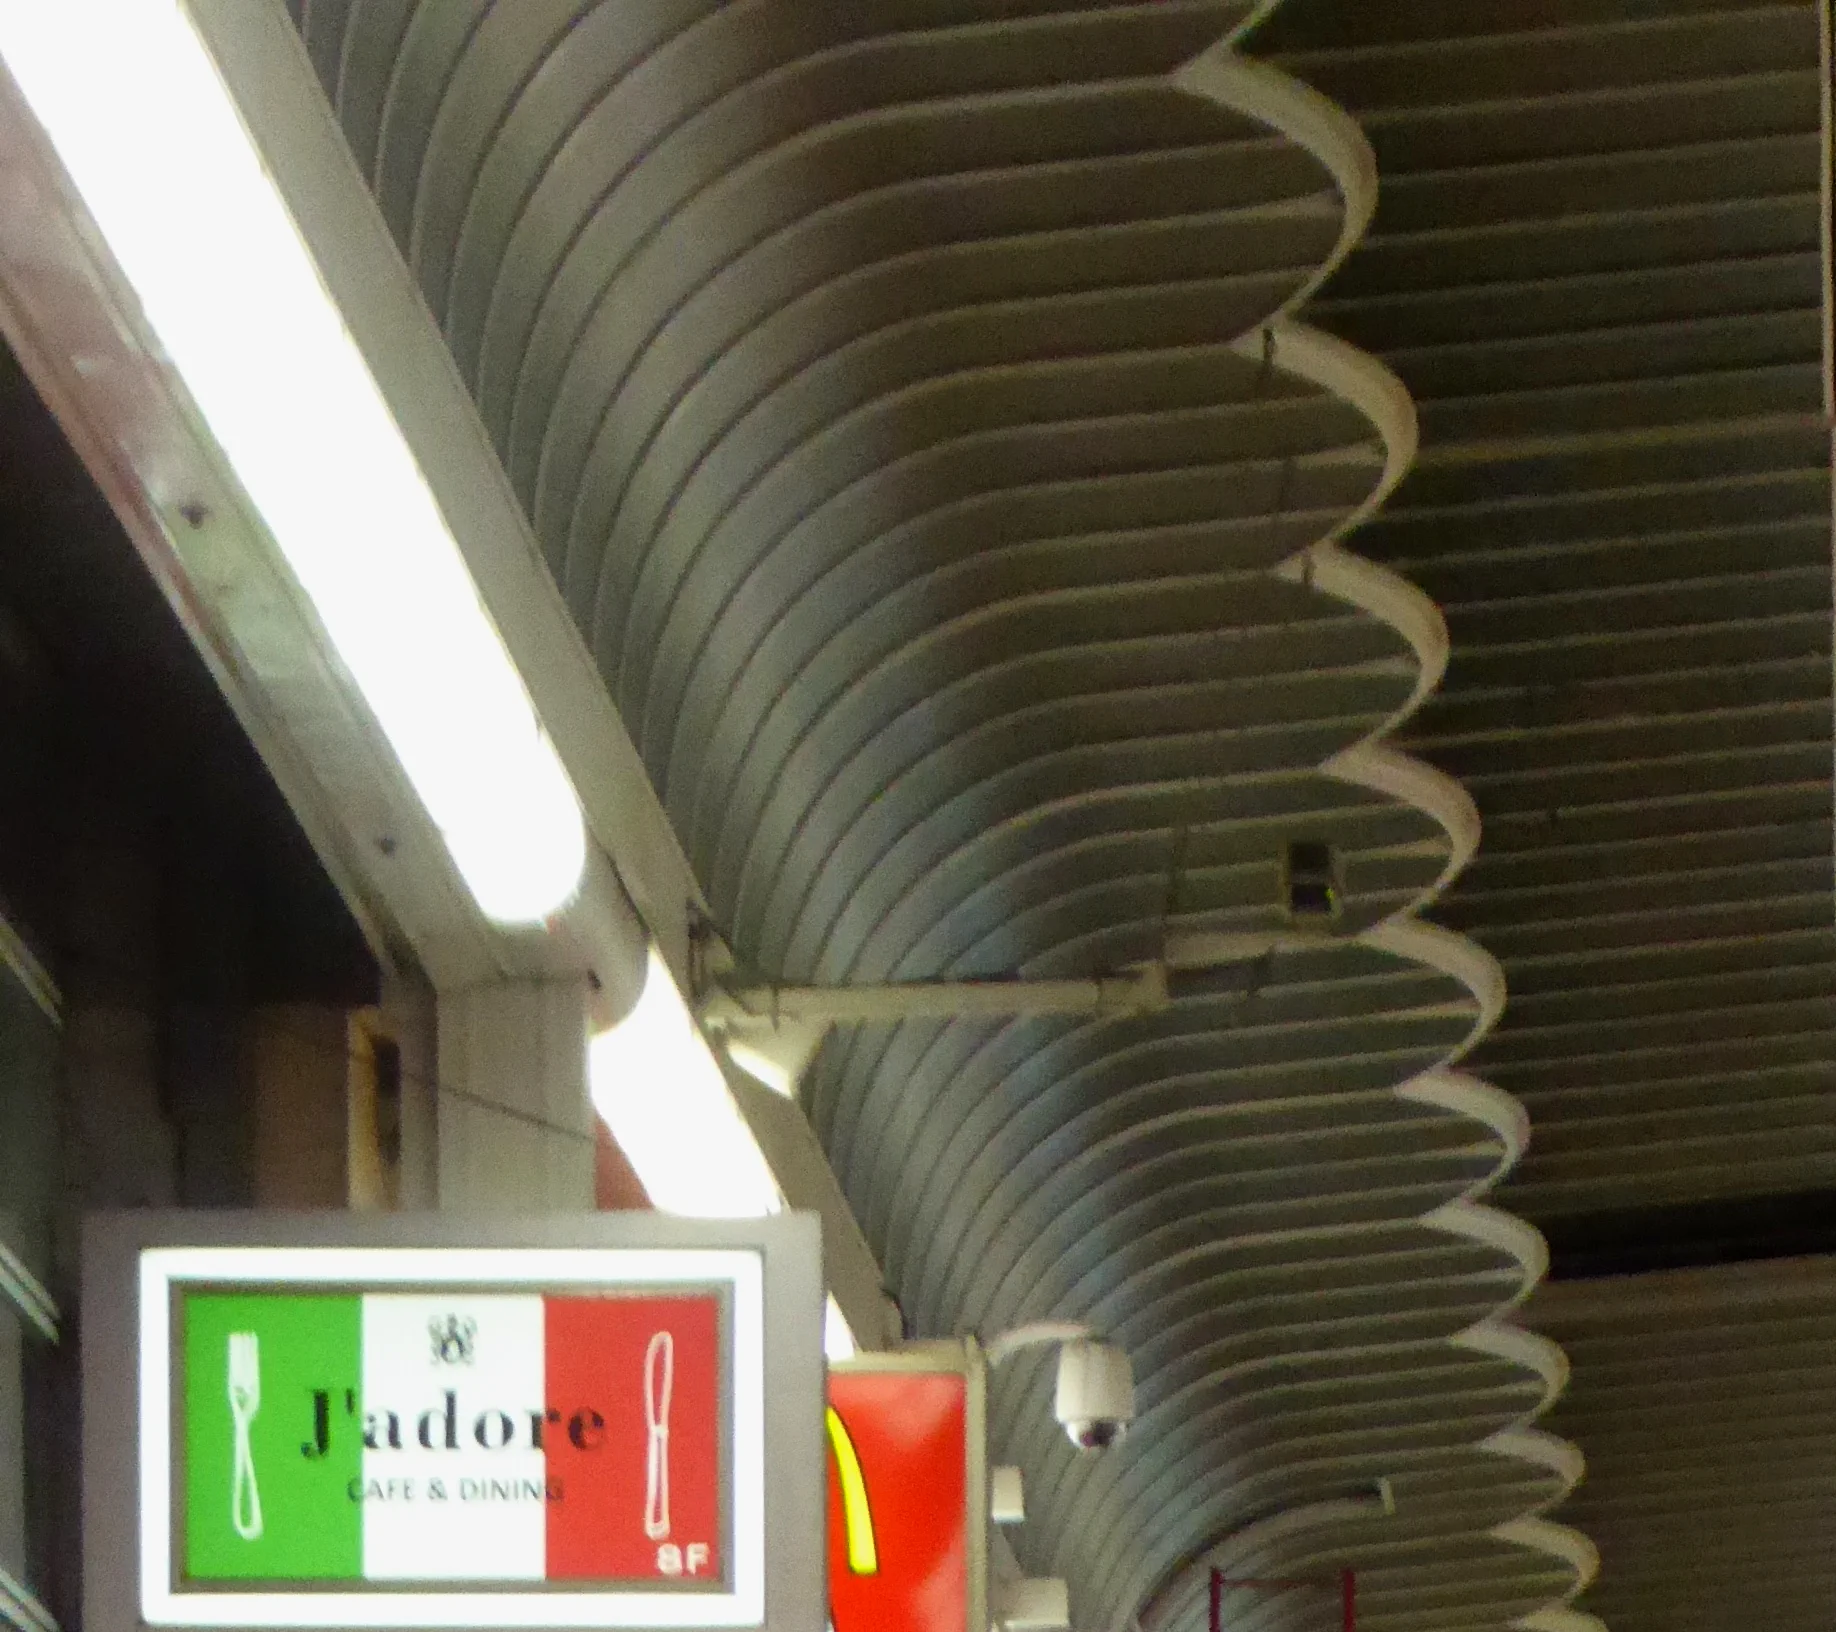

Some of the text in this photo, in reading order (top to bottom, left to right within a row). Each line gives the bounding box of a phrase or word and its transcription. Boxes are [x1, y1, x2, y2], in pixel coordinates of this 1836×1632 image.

[301, 1388, 605, 1459] J'adore
[428, 1477, 448, 1502] &
[459, 1477, 566, 1503] DINING
[656, 1543, 710, 1575] 8F
